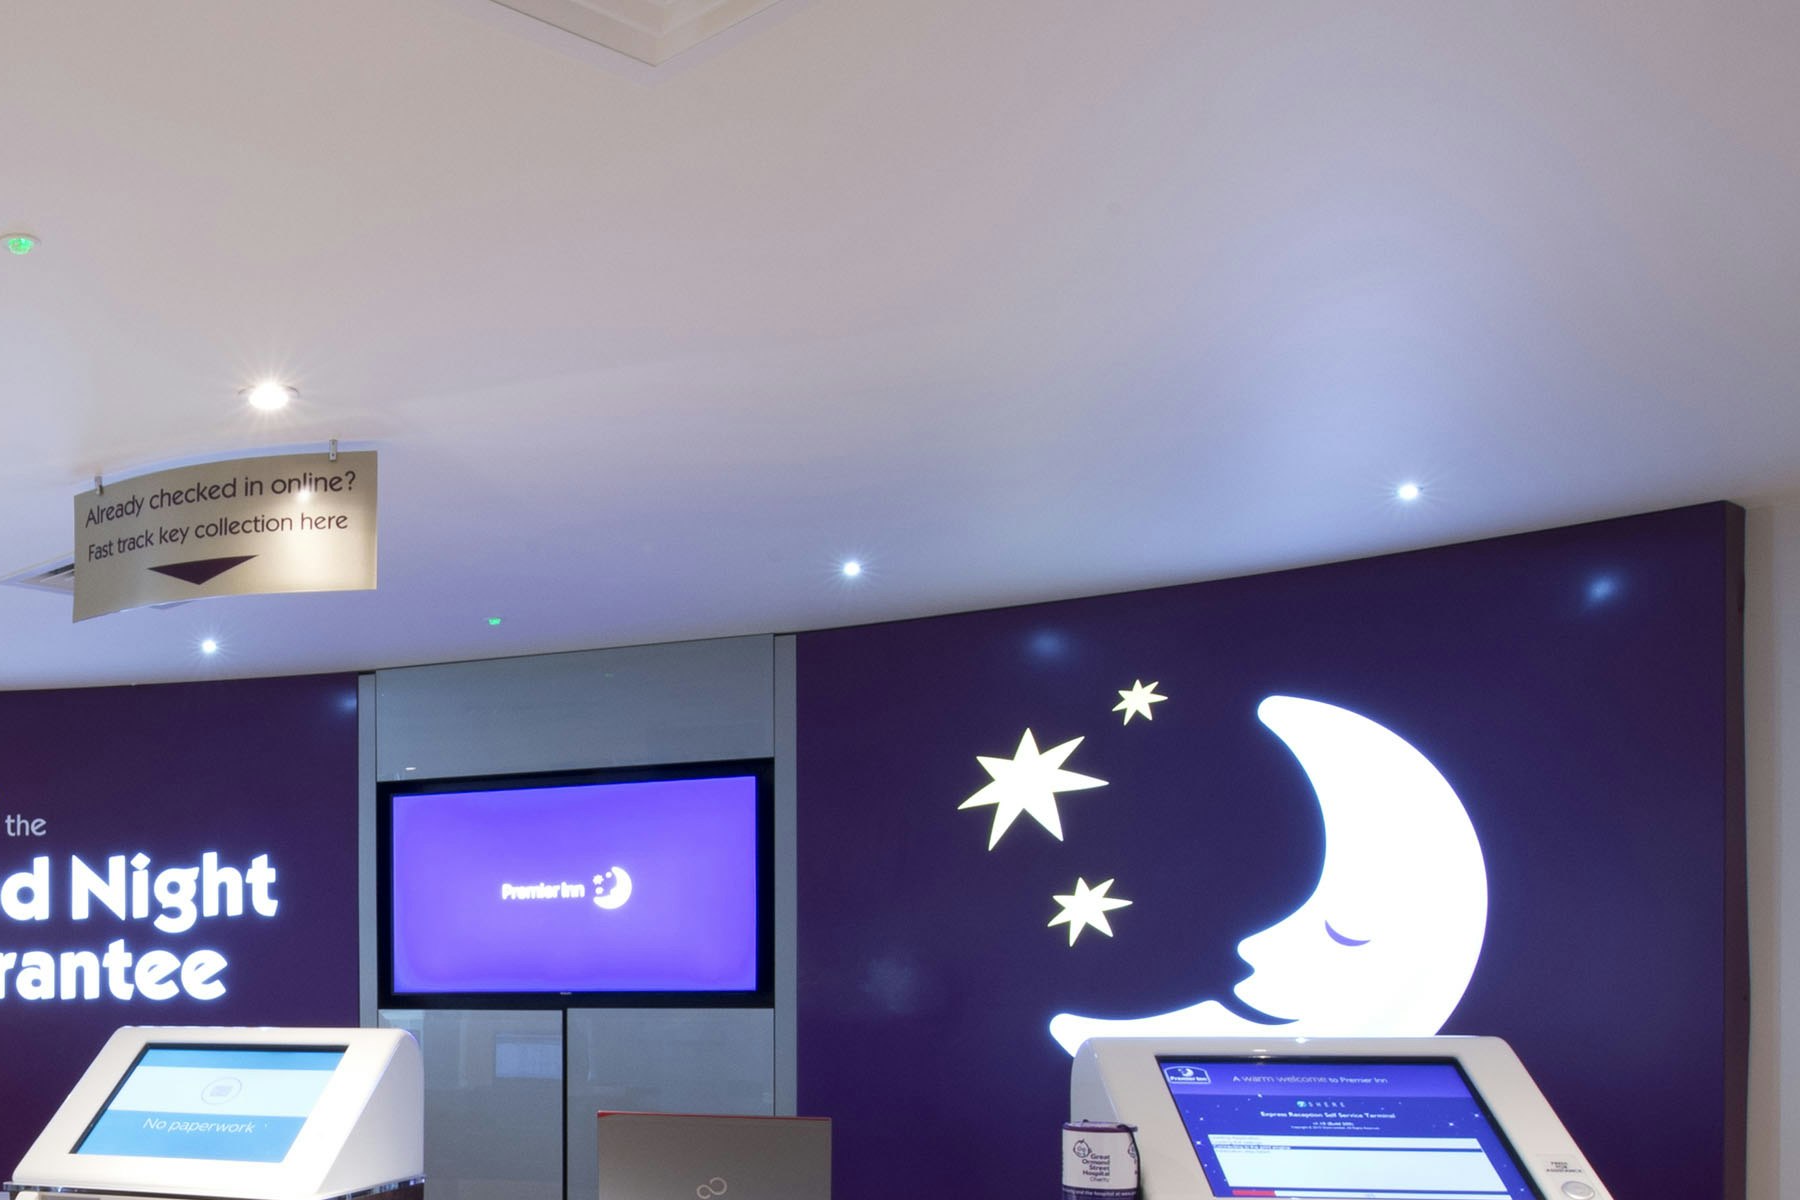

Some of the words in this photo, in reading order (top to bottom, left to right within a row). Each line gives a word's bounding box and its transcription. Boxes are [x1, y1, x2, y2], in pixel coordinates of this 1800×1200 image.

[85, 496, 145, 528] Already
[149, 477, 237, 510] checked
[244, 475, 264, 497] in
[271, 470, 357, 495] online?
[88, 543, 114, 562] Fast
[117, 529, 154, 554] track
[158, 524, 190, 545] key
[194, 514, 293, 540] collection
[300, 512, 349, 531] here
[4, 812, 48, 837] the
[71, 851, 280, 934] Night
[502, 882, 560, 900] Premier
[1232, 1075, 1241, 1083] A
[1242, 1075, 1274, 1084] warm
[1277, 1075, 1328, 1084] welcome
[1340, 1076, 1372, 1085] Premier
[1374, 1076, 1388, 1085] Inn
[142, 1117, 167, 1131] No
[167, 1119, 256, 1134] paperwork
[1260, 1111, 1288, 1119] Express
[1288, 1111, 1324, 1119] Reception
[1338, 1111, 1363, 1119] Service
